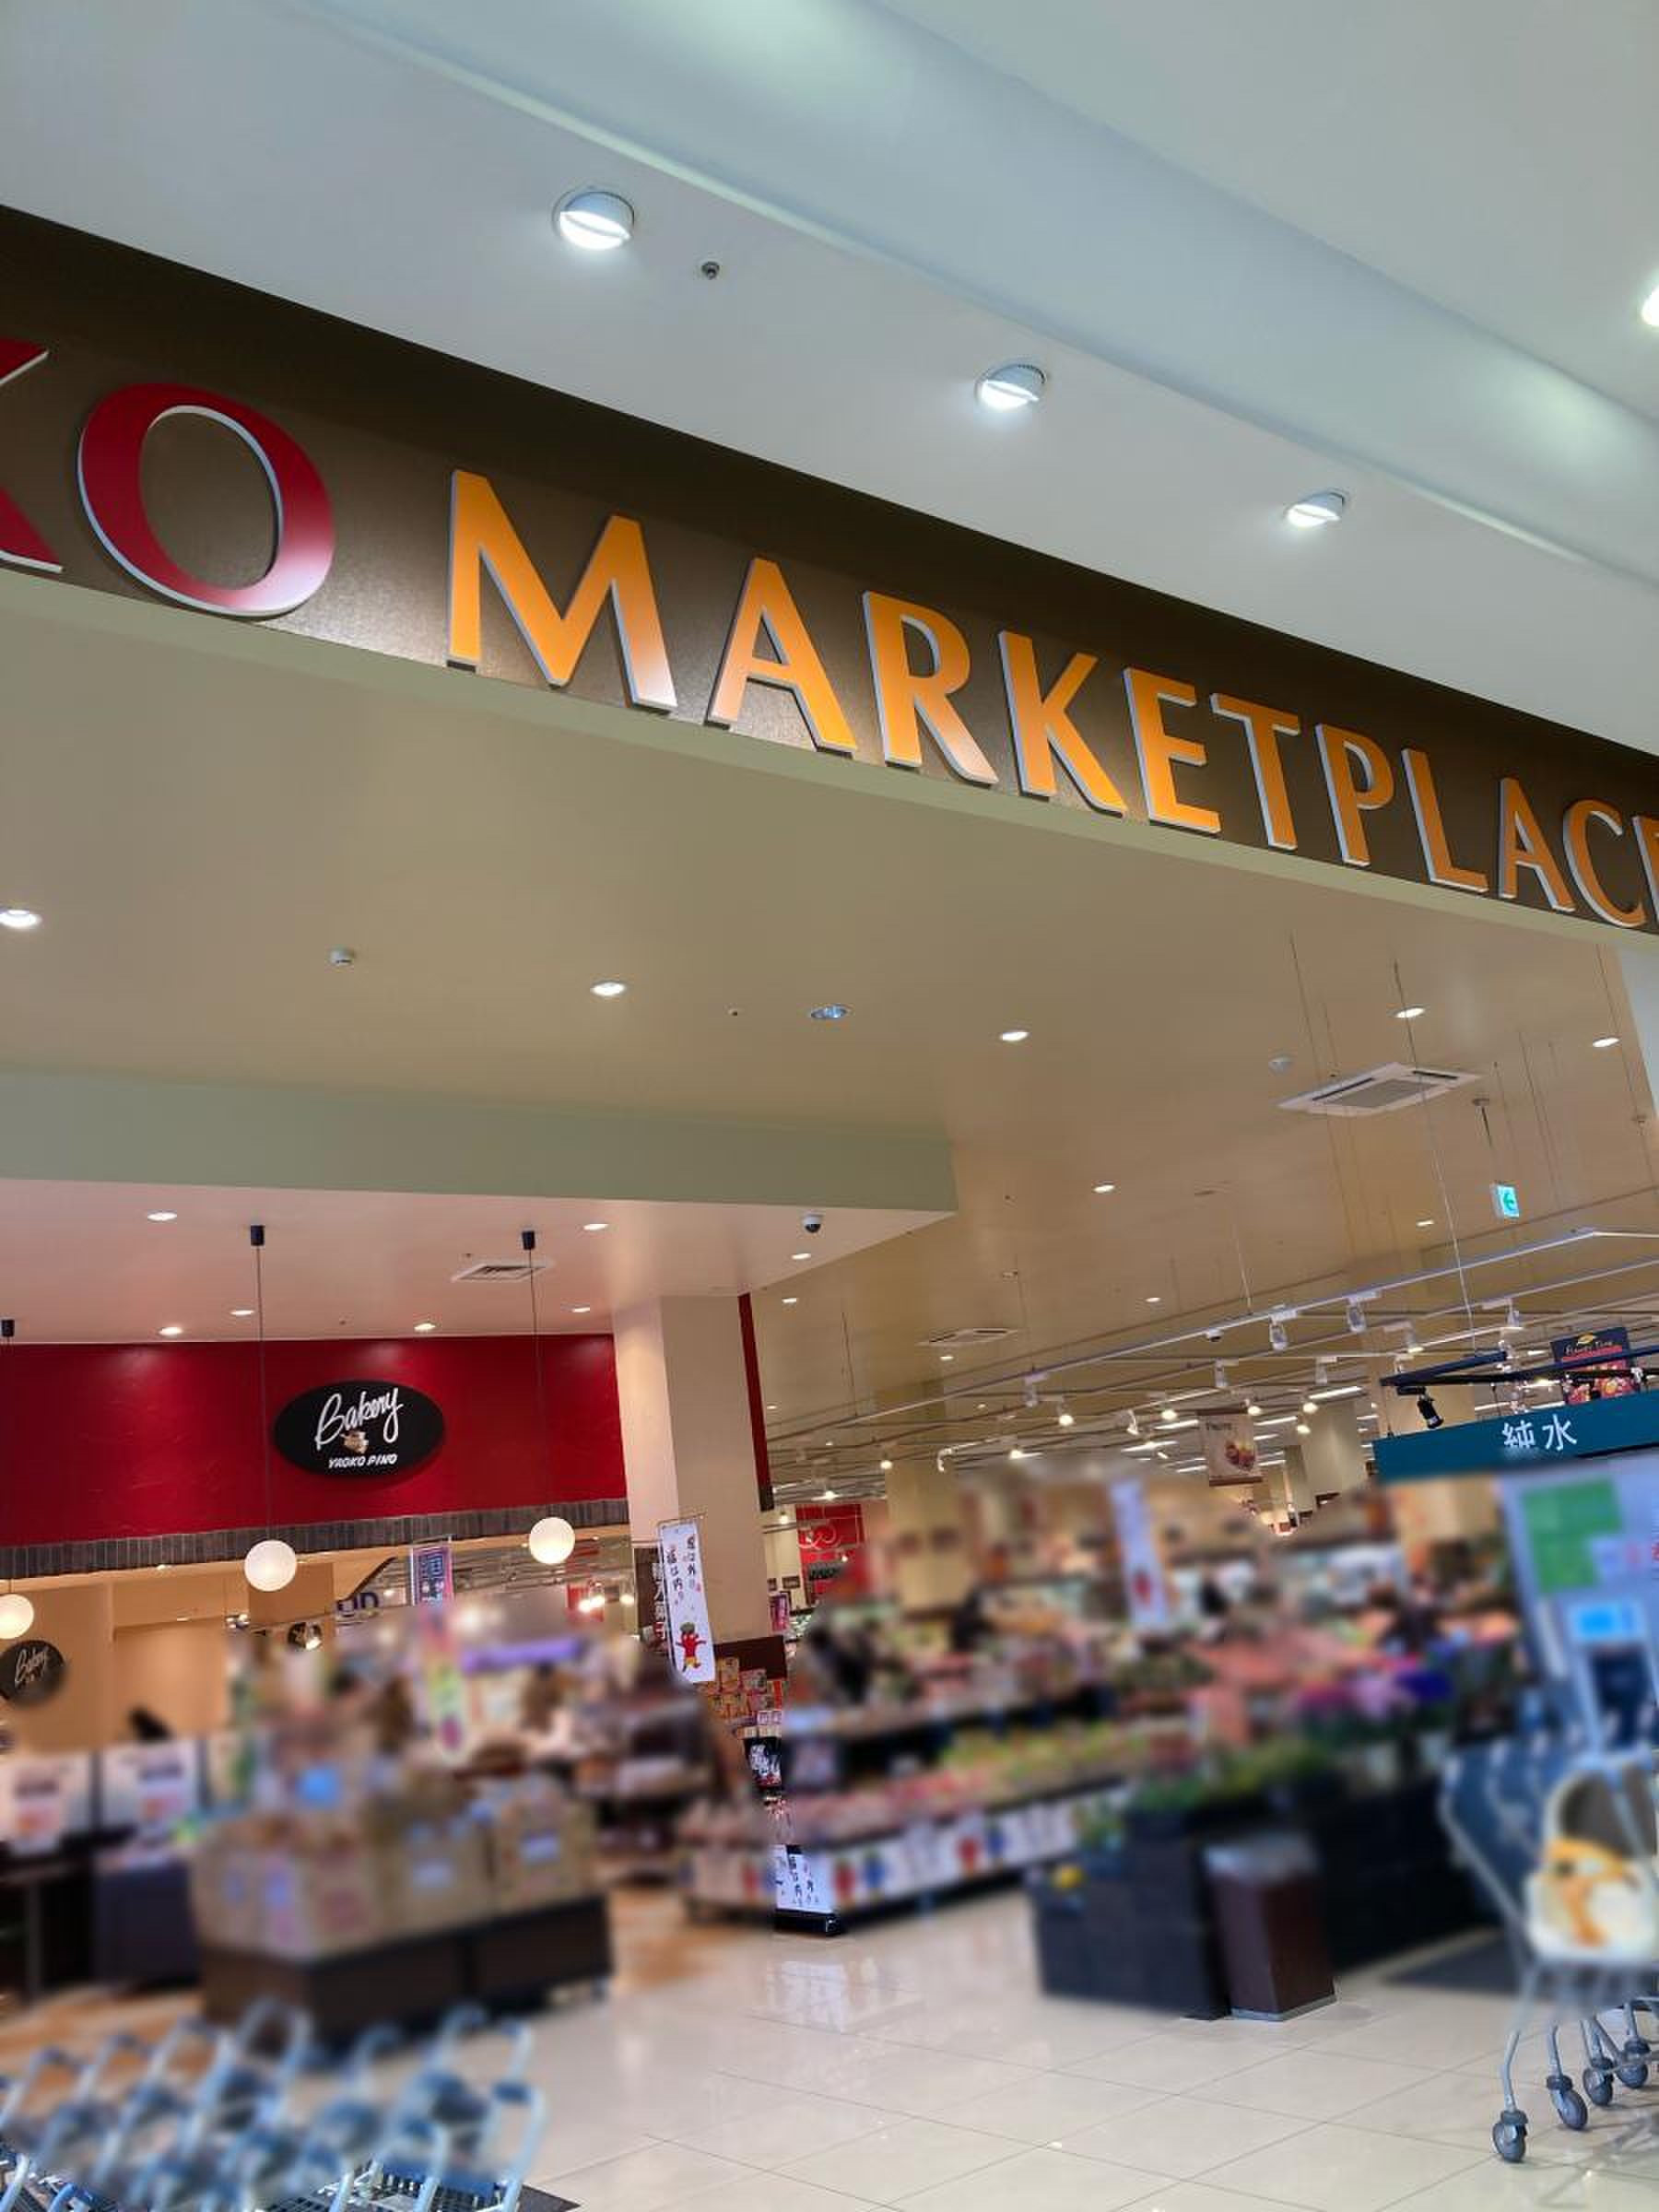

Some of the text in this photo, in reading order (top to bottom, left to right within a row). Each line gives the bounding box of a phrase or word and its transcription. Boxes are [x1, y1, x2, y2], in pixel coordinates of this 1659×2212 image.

[314, 1387, 404, 1451] Bakery
[1501, 1413, 1577, 1452] 純水
[328, 1453, 397, 1468] YAOKO PINO
